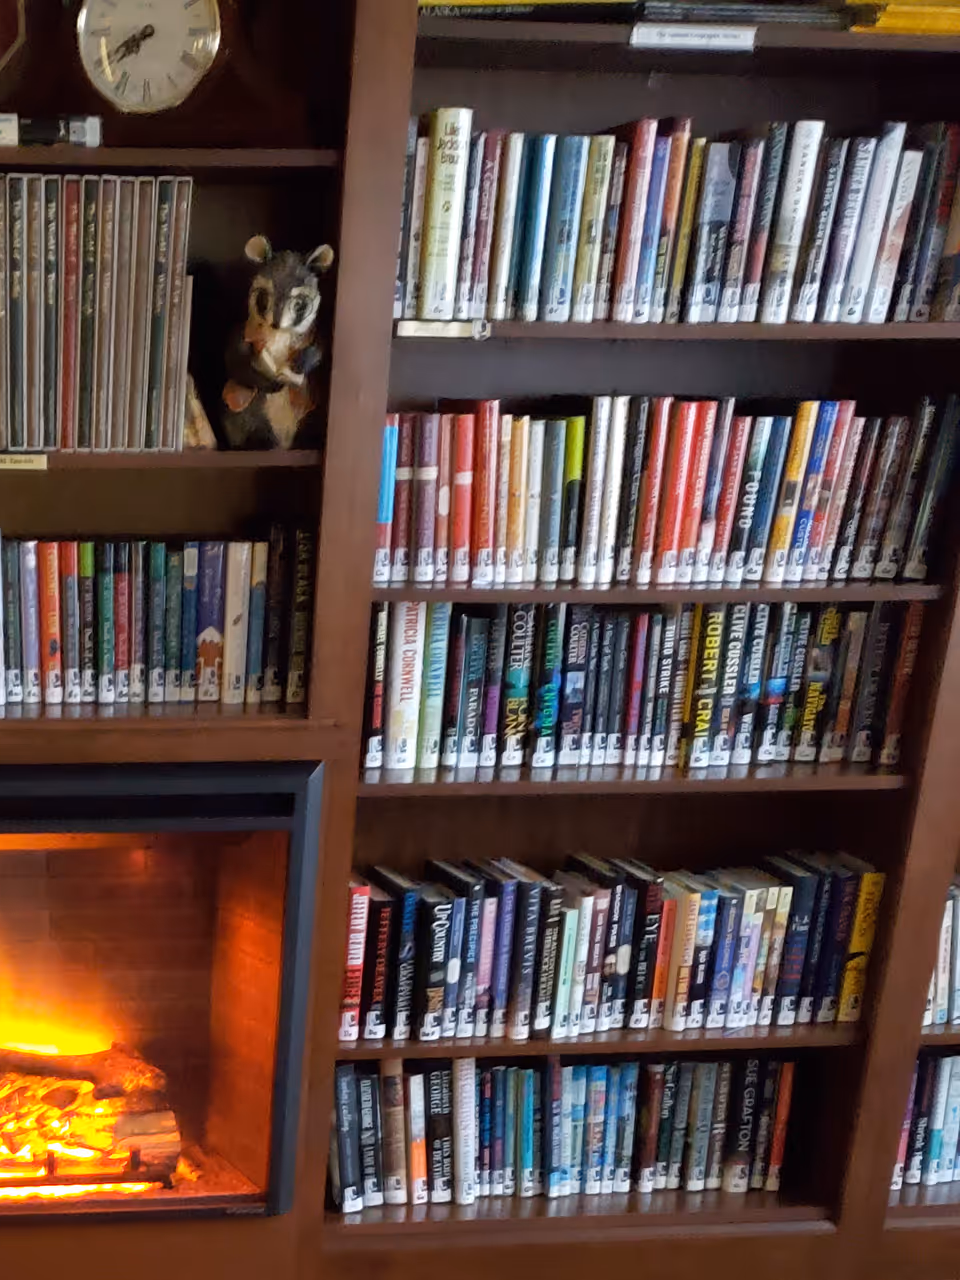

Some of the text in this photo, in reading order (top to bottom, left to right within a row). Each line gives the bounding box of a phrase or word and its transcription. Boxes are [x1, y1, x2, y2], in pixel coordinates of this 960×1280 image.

[399, 601, 420, 703] PATRICIA CORNWELL
[509, 610, 527, 671] COULTER
[567, 623, 581, 665] COULTER
[722, 604, 746, 695] CLIVE CUSSLER
[749, 637, 765, 684] CUSSLER
[659, 658, 673, 695] STRIKE
[694, 610, 724, 738] ROBERT CRAI
[790, 647, 806, 692] CUSSLER
[465, 687, 480, 737] PARADO
[802, 681, 823, 732] NAVIGATO
[347, 893, 368, 966] JEFFERY DEAVER
[466, 899, 480, 964] THE PRECIPICE
[522, 886, 541, 975] VITA BREVIS
[609, 924, 620, 948] PASS
[644, 914, 661, 944] EYE
[371, 907, 392, 1003] JEFFERY DEAVER
[430, 1071, 443, 1116] GEORGE
[737, 1059, 759, 1152] SUE GRAFTON
[915, 1116, 929, 1149] Shrink
